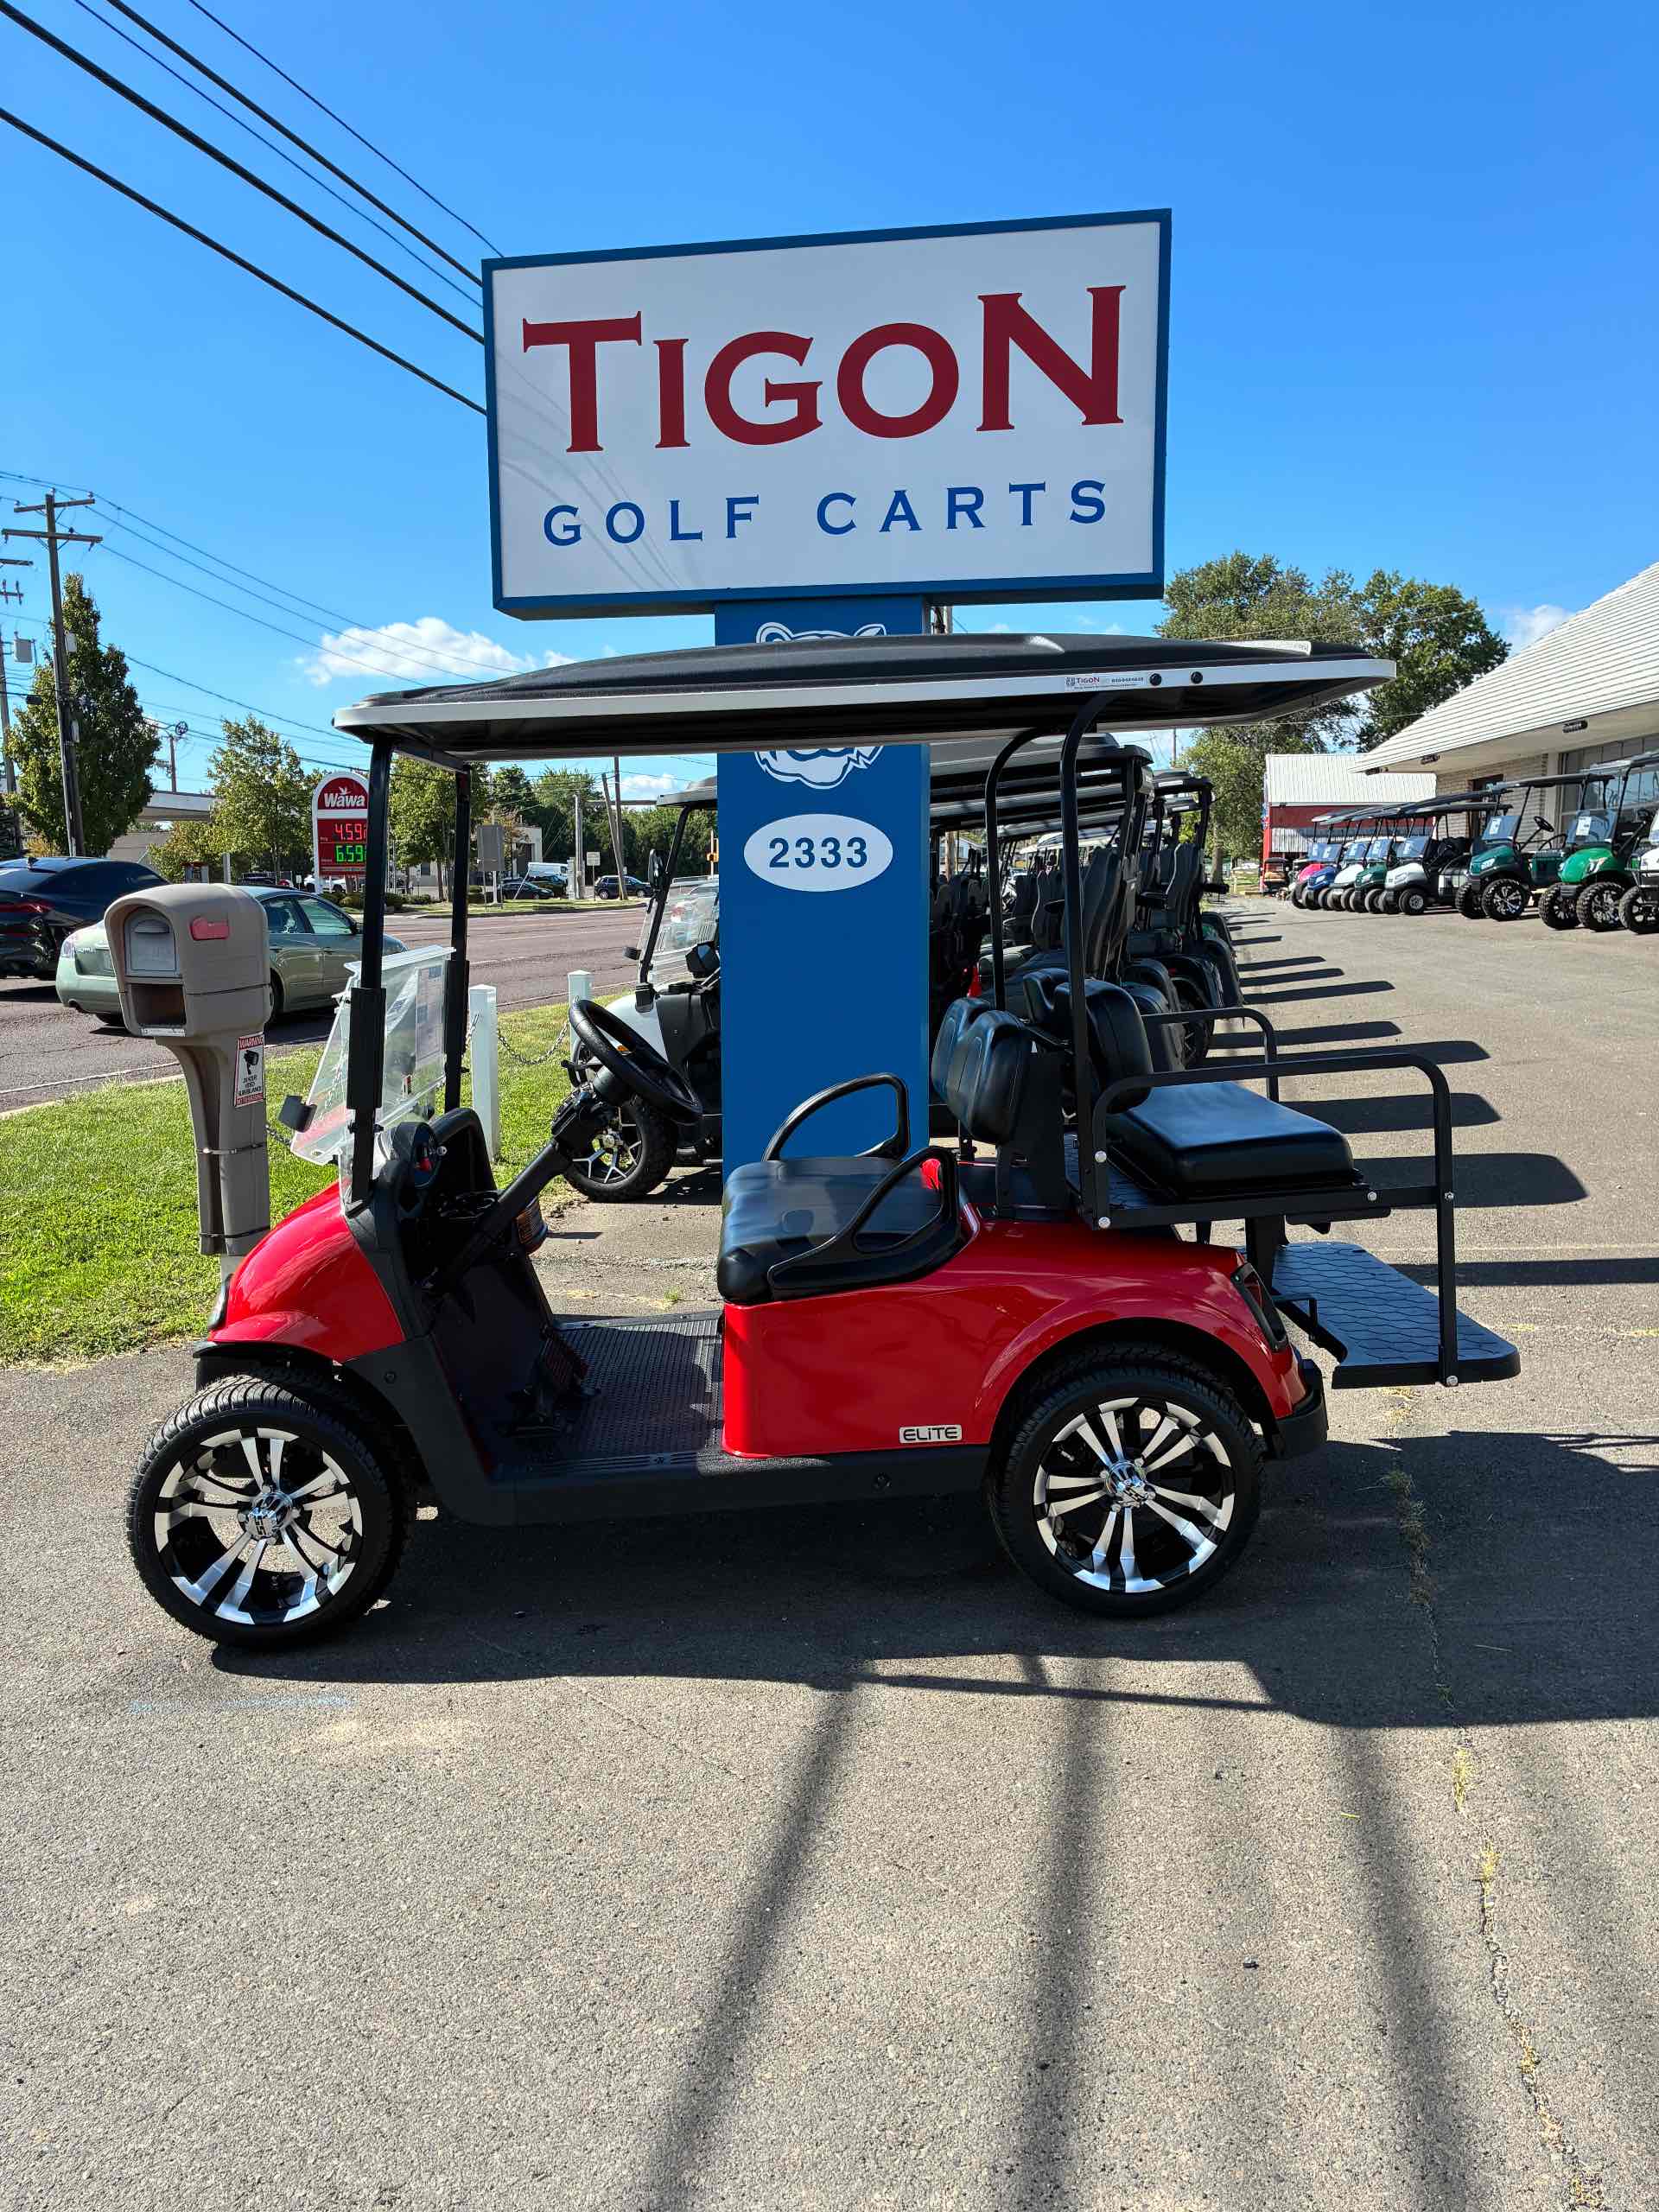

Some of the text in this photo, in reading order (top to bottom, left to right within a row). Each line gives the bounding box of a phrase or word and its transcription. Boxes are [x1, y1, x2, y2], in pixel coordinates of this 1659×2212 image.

[522, 285, 1127, 453] TIGON
[543, 480, 1107, 546] GOLF CARTS
[323, 792, 365, 808] Wawa
[768, 836, 868, 868] 2333
